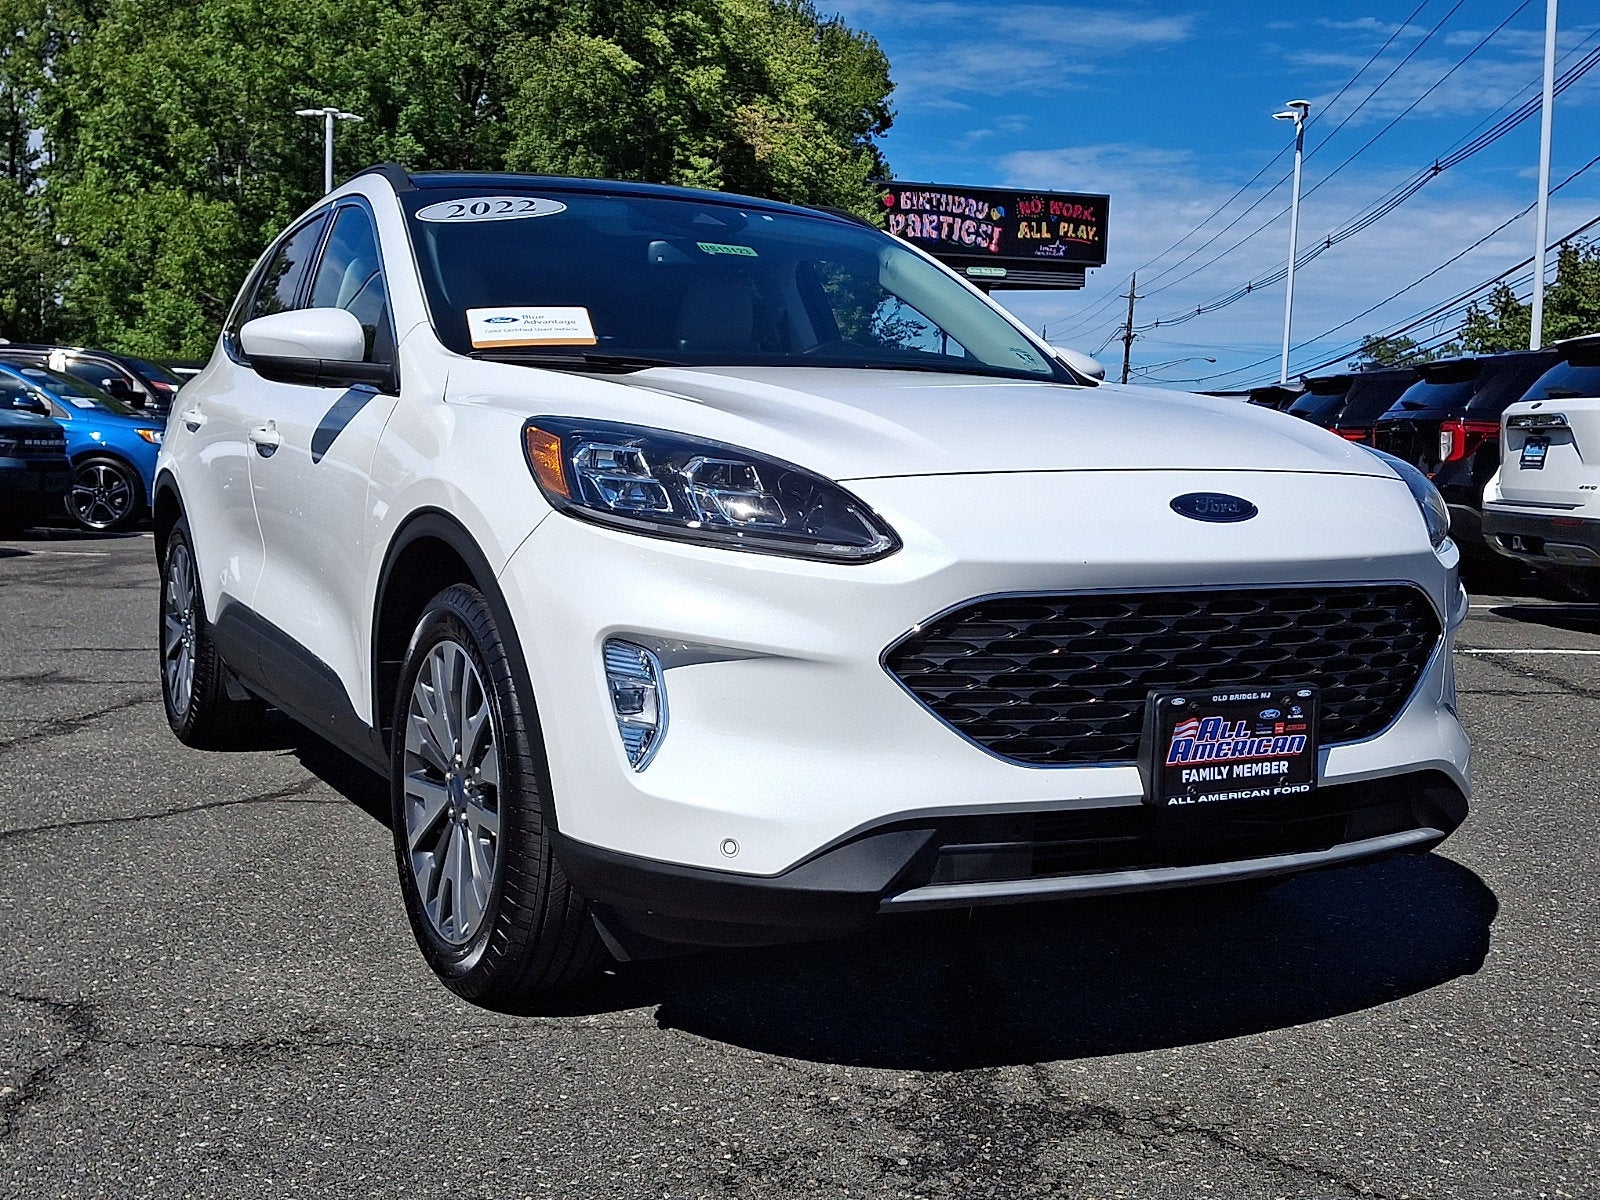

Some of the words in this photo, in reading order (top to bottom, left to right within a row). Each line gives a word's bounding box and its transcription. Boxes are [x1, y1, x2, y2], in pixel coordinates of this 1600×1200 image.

[446, 199, 538, 219] 2022
[899, 191, 989, 220] BIRTHDAY
[1018, 199, 1043, 216] NO
[1017, 221, 1051, 240] ALL
[1195, 496, 1240, 513] Ford
[1198, 716, 1251, 743] ALL
[1165, 735, 1307, 764] AMERICAN
[1181, 765, 1230, 784] FAMILY
[1232, 760, 1289, 778] MEMBER
[1167, 797, 1195, 806] ALL
[1197, 788, 1271, 803] AMERICAN
[1273, 784, 1310, 795] FORD
